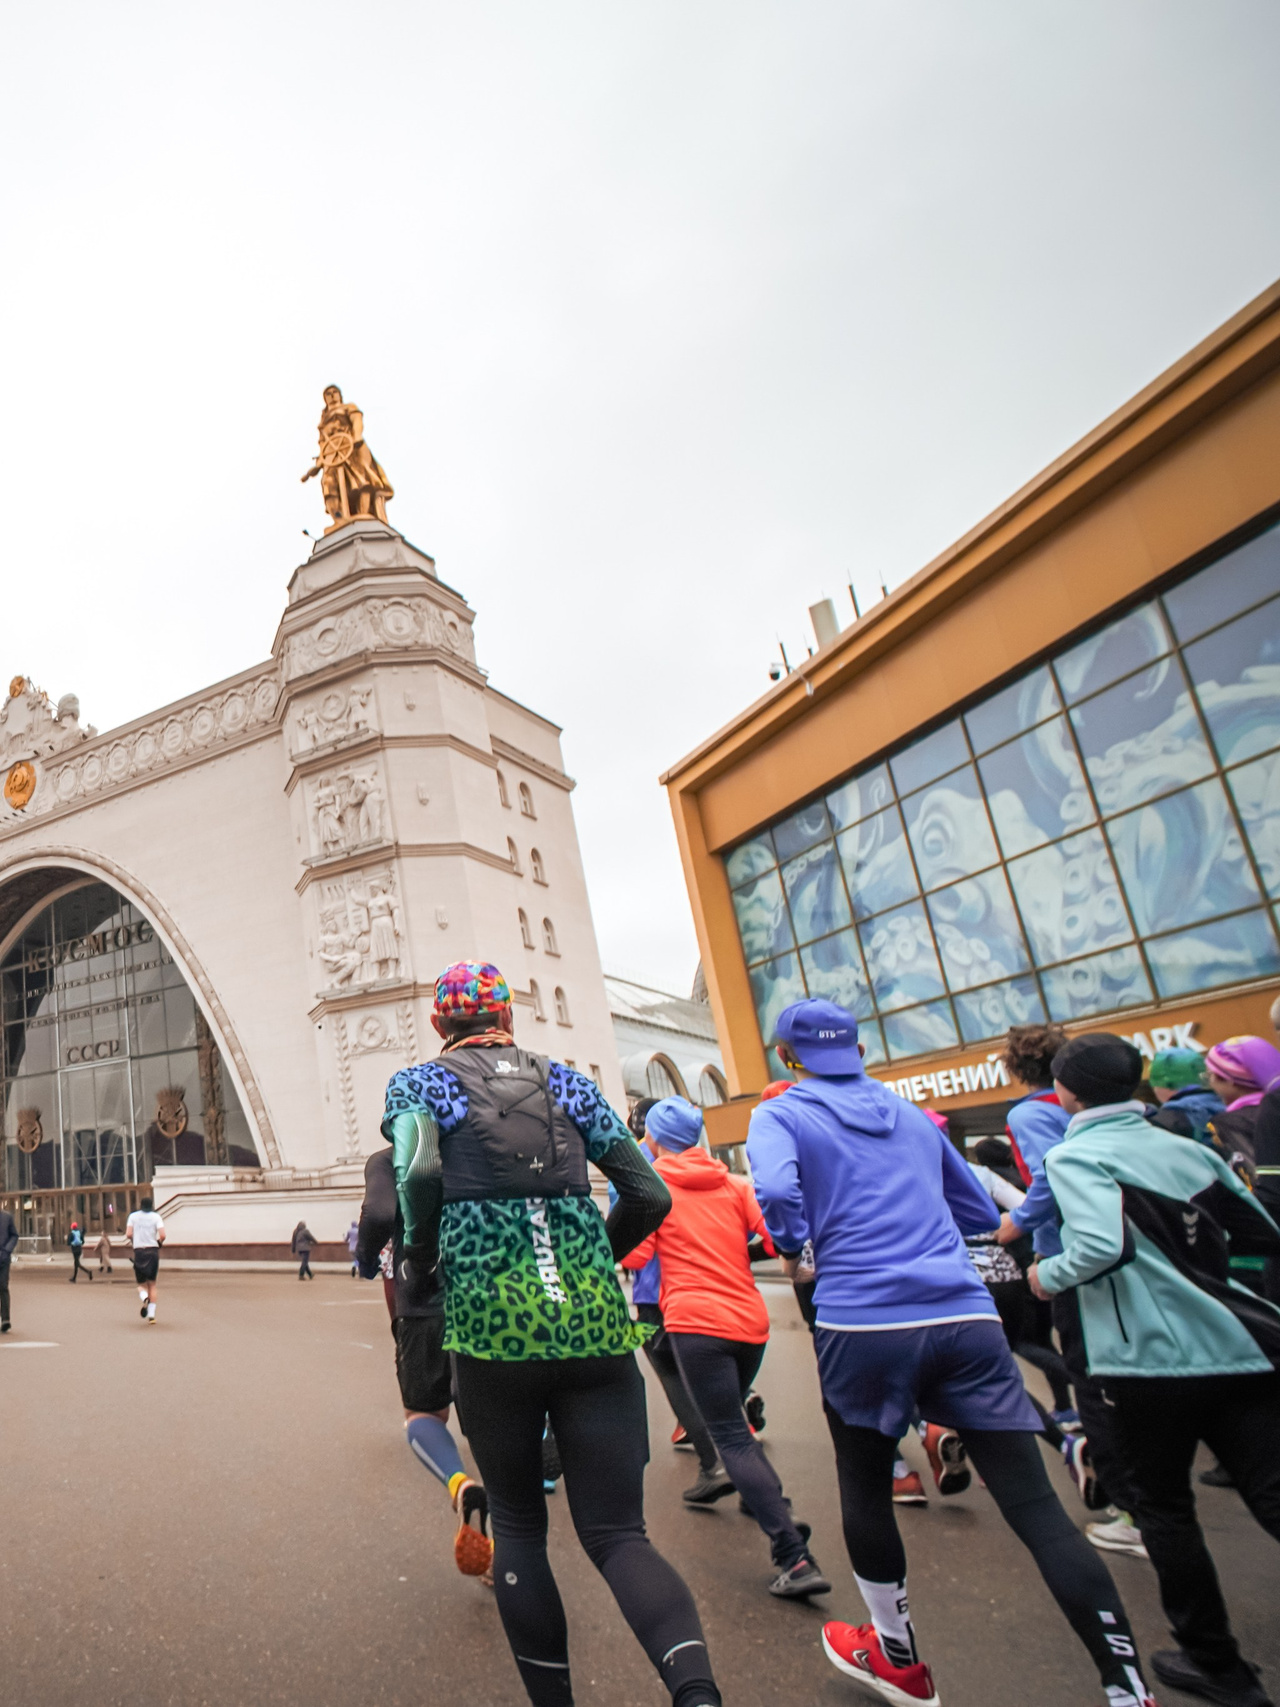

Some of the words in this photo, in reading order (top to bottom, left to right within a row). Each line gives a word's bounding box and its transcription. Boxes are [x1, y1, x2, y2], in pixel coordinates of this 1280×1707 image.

[27, 921, 154, 973] КОСМОС
[818, 1029, 836, 1039] ВТБ
[1121, 1021, 1209, 1061] ARK
[67, 1040, 120, 1066] СССР
